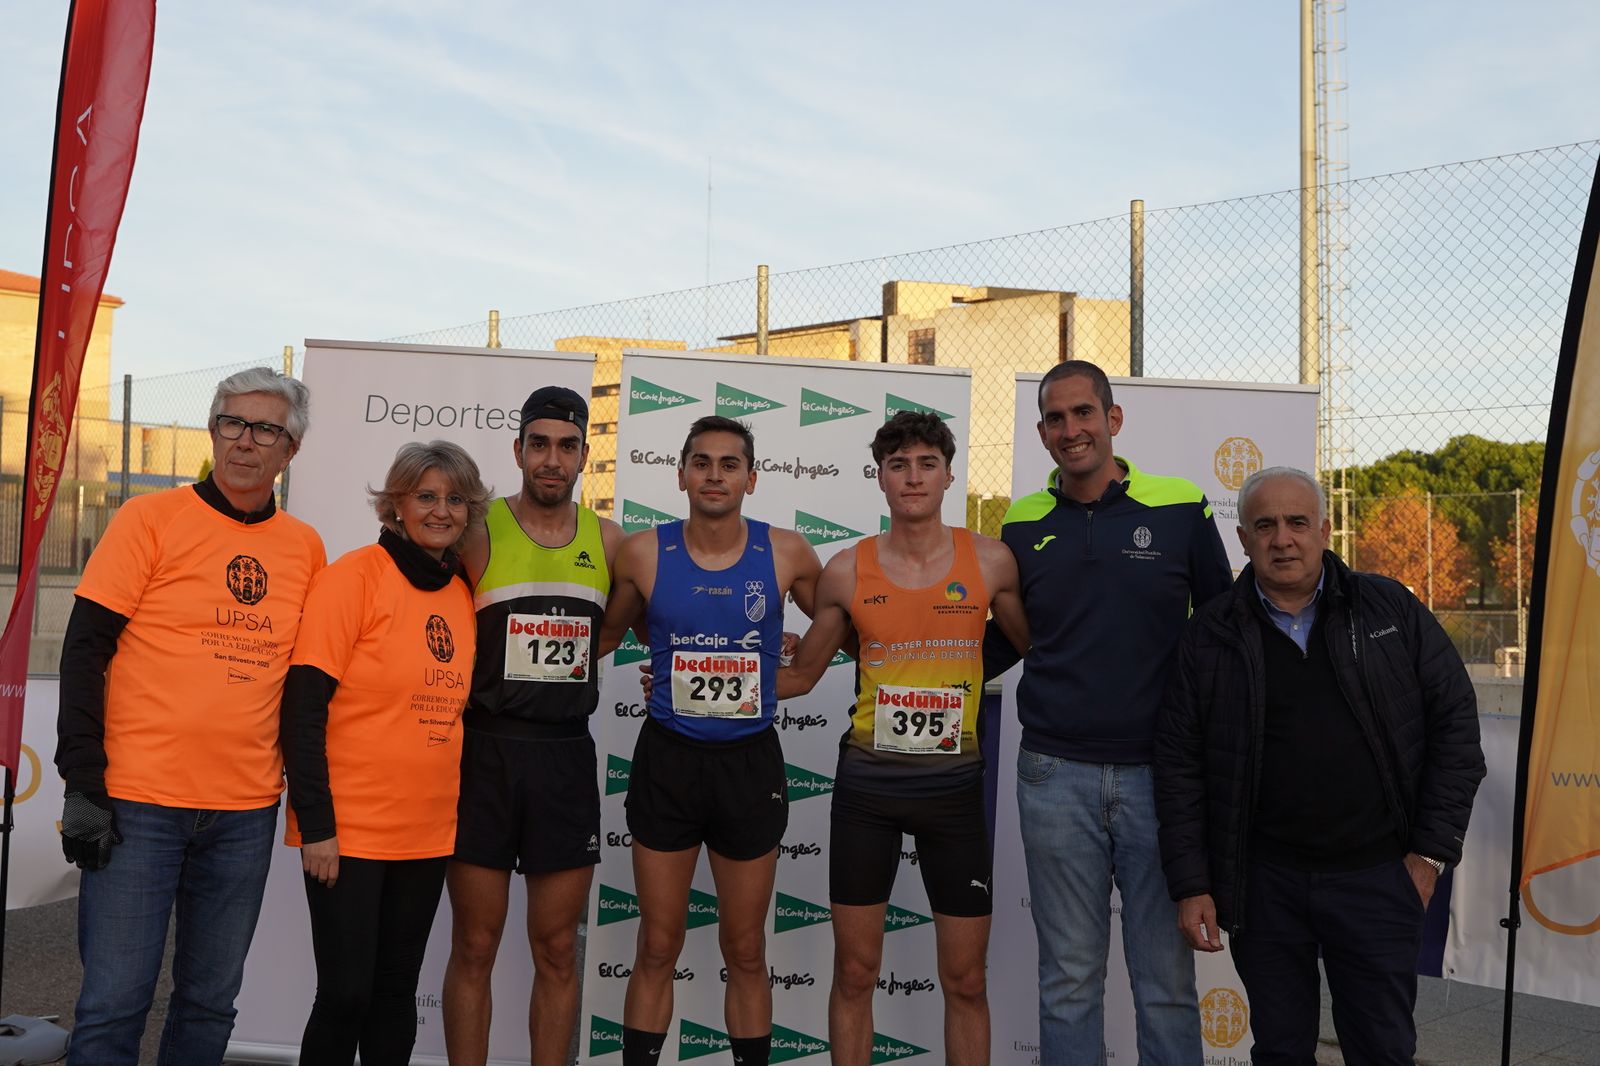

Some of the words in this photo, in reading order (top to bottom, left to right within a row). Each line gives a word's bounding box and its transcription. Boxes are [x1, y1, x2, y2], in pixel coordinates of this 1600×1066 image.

[631, 390, 639, 399] El
[639, 392, 658, 402] Corte
[657, 391, 685, 405] Inglés
[717, 396, 725, 405] El
[725, 398, 744, 407] Corte
[742, 396, 771, 410] Inglés
[365, 394, 521, 433] Deportes
[802, 401, 810, 411] El
[810, 403, 828, 413] Corte
[827, 402, 855, 415] Inglés
[887, 407, 895, 416] El
[630, 449, 644, 464] El
[645, 451, 676, 465] Corte
[762, 459, 793, 473] Corte
[794, 457, 840, 480] Inglés
[863, 465, 876, 479] El
[624, 514, 632, 523] El
[632, 514, 651, 525] Corte
[796, 525, 804, 534] El
[804, 525, 823, 535] Corte
[822, 525, 850, 538] Inglés
[216, 607, 273, 634] UPSA
[509, 618, 589, 638] bedunia
[201, 631, 251, 642] CORREMOS
[201, 638, 219, 646] POR
[221, 640, 234, 649] LA
[527, 639, 575, 665] 123
[891, 640, 922, 651] ESTER
[214, 652, 227, 661] San
[228, 655, 256, 665] Silvestre
[674, 655, 758, 673] bedunia
[424, 667, 465, 690] UPSA
[690, 676, 743, 702] 293
[411, 694, 449, 704] CORREMOS
[878, 687, 962, 709] bedunia
[410, 703, 425, 711] POR
[425, 704, 435, 712] LA
[615, 702, 629, 717] El
[781, 707, 827, 731] Inglés
[892, 710, 945, 737] 395
[608, 769, 617, 778] El
[791, 778, 811, 788] Corte
[606, 831, 621, 847] El
[600, 899, 609, 909] El
[608, 900, 628, 910] Corte
[688, 903, 698, 913] El
[698, 904, 716, 914] Corte
[777, 907, 786, 916] El
[785, 908, 805, 917] Corte
[890, 913, 920, 925] Inglés
[598, 963, 613, 978] El
[719, 967, 728, 982] E
[769, 966, 815, 990] Inglés
[887, 971, 935, 996] Inglés
[592, 1031, 601, 1040] El
[600, 1032, 621, 1042] Corte
[681, 1034, 689, 1044] El
[690, 1035, 709, 1046] Corte
[770, 1039, 779, 1048] El
[778, 1039, 798, 1050] Corte
[797, 1038, 826, 1052] Inglés
[885, 1042, 914, 1056] Inglés
